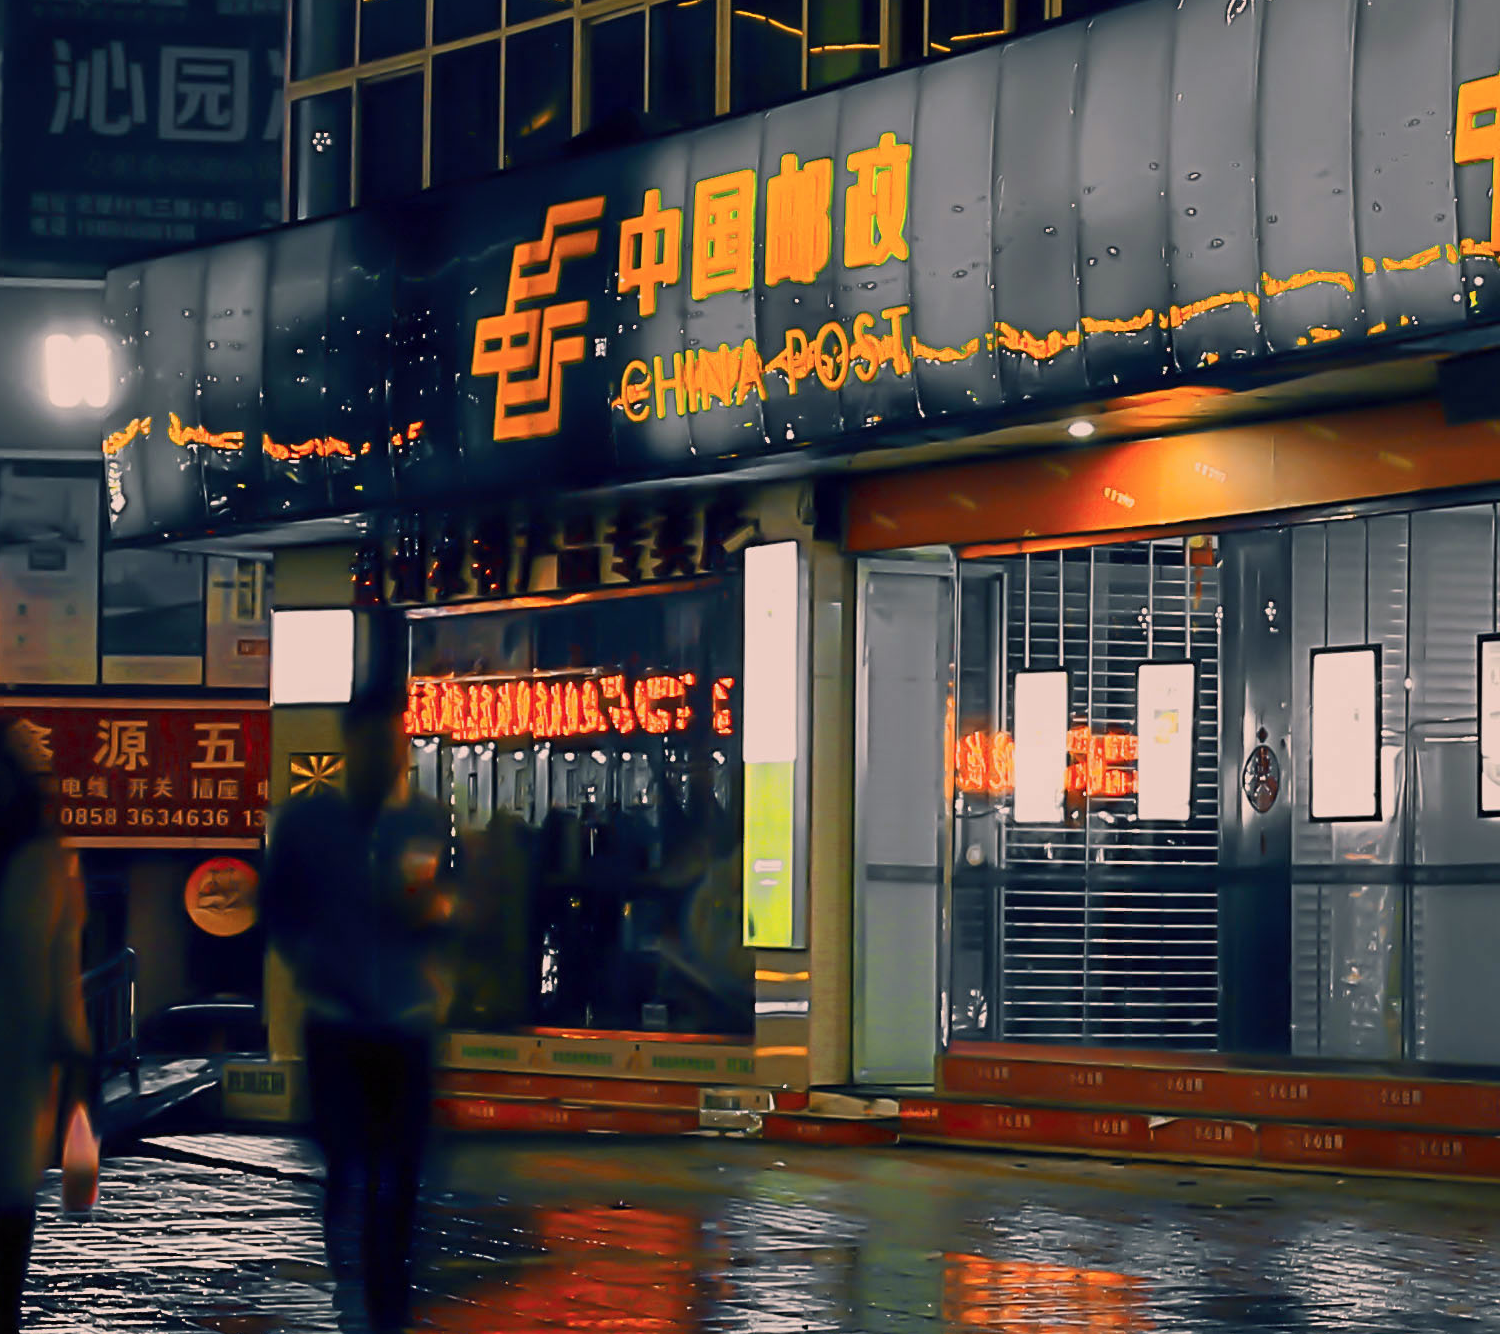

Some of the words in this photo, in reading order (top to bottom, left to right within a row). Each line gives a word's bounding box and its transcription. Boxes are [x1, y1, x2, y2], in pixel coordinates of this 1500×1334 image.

[617, 131, 913, 317] 中国邮政
[621, 337, 767, 422] CHINA
[784, 305, 911, 395] POST
[60, 807, 117, 826] 0858
[126, 808, 229, 827] 3634636
[128, 778, 173, 799] 开关
